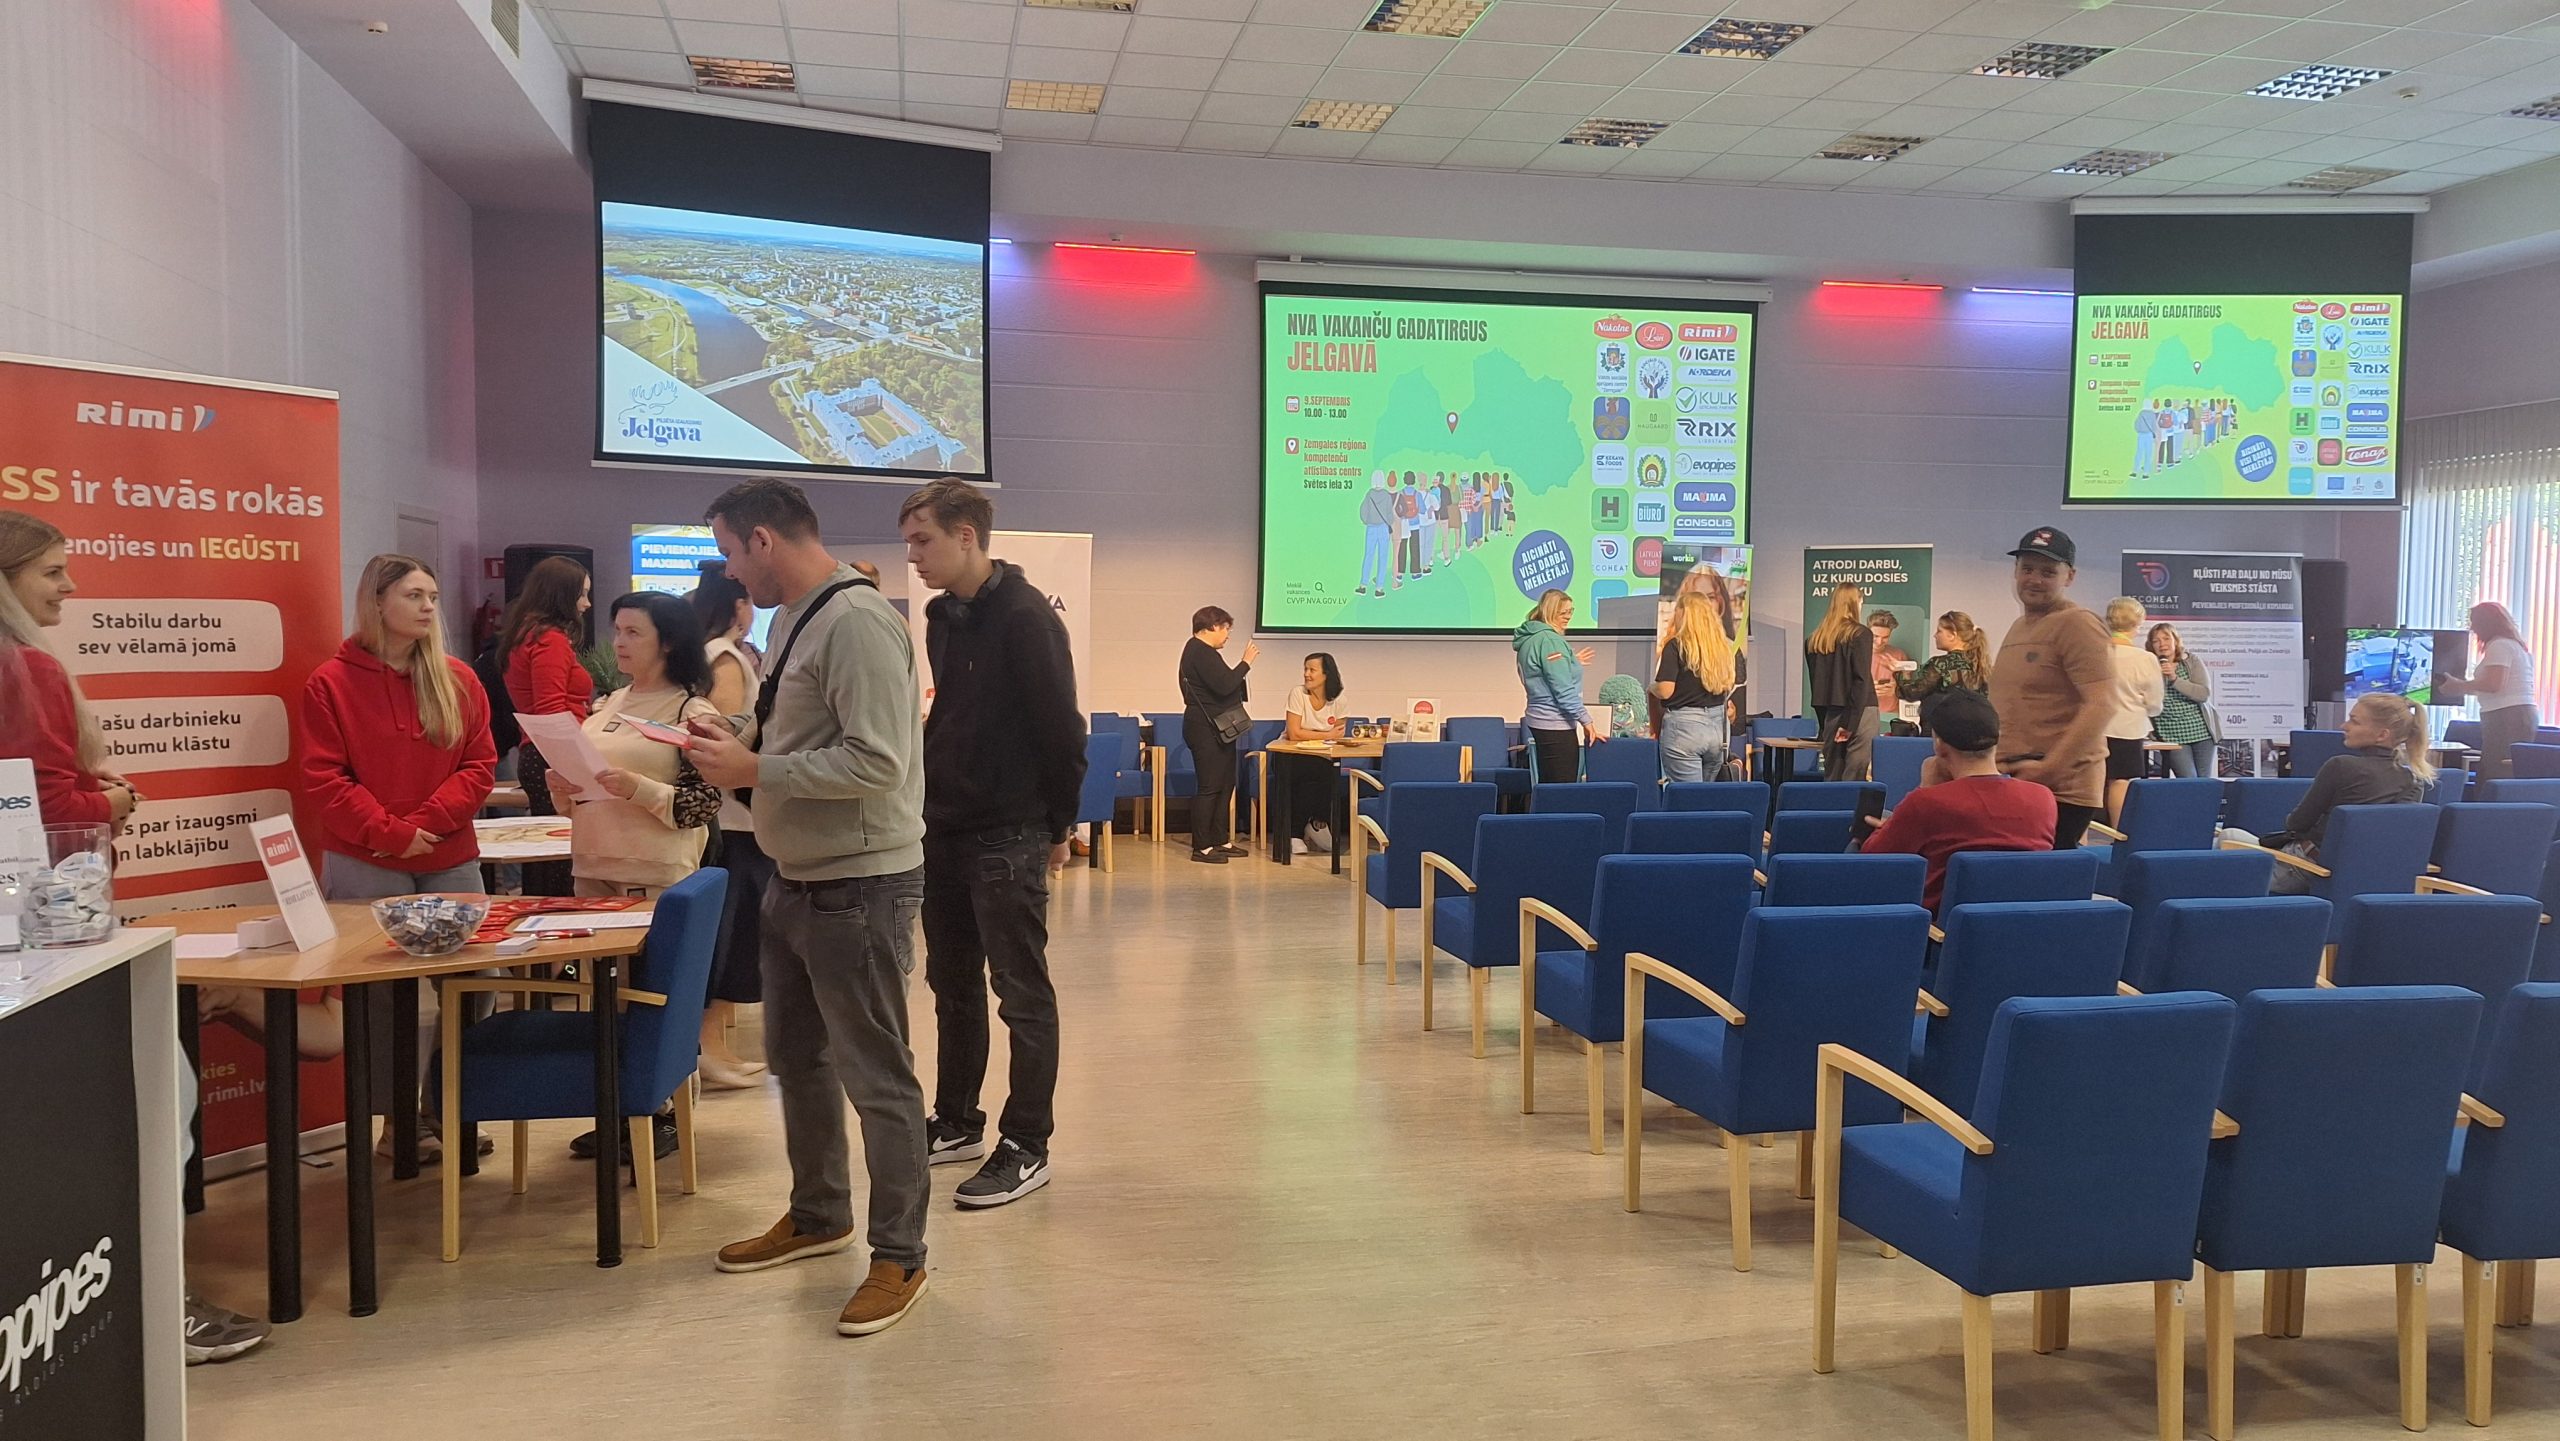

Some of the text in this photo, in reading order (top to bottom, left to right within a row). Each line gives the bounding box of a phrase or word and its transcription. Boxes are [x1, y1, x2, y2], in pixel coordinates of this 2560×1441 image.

[2092, 302, 2222, 318] NVA VAKANČU GADATIRGUS
[1287, 310, 1488, 341] NVA VAKANČU GADATIRGUS
[1684, 326, 1722, 338] Rimi
[2091, 319, 2149, 339] JELGAVĀ
[1287, 339, 1377, 373] JELGAVĀ
[1695, 348, 1735, 361] IGATE
[2364, 364, 2390, 373] RIX
[1699, 392, 1738, 405] KULK
[75, 401, 184, 432] Rimi
[1304, 408, 1322, 418] 10.00
[1329, 409, 1347, 418] 13.00
[622, 417, 701, 447] Jelgava
[1699, 422, 1736, 437] RIX
[1693, 458, 1736, 472] evopipes
[0, 466, 324, 517] SS ir tavās rokās
[1344, 480, 1353, 489] 33
[1683, 491, 1727, 503] MAXIMA
[1601, 496, 1619, 517] H
[1676, 518, 1732, 527] CONSOLIS
[64, 533, 300, 561] enojies un IEGŪSTI
[1521, 540, 1557, 564] AICINĀTI
[1519, 550, 1566, 579] VISI DARBA
[1673, 553, 1695, 563] workis
[1813, 559, 1902, 570] ATRODI DARBU,
[1523, 562, 1569, 591] MEKLĒTĀJI
[1813, 572, 1908, 583] UZ KURU DOSIES
[2222, 569, 2237, 579] PAR
[2260, 570, 2270, 579] NO
[2271, 568, 2292, 580] MŪSU
[1812, 587, 1828, 597] AR
[2210, 581, 2278, 593] VEIKSMES STĀSTA
[92, 612, 222, 629] Stabilu darbu
[78, 638, 237, 658] sev vēlamā jomā
[96, 710, 241, 731] ašu darbinieku
[2226, 714, 2283, 724] 400+ 30
[105, 737, 230, 757] abumu klāstu
[140, 819, 170, 838] par
[176, 808, 258, 834] izaugsmi
[136, 837, 229, 861] labklājību
[201, 1062, 236, 1081] kies
[203, 1078, 265, 1105] .rimi.lv
